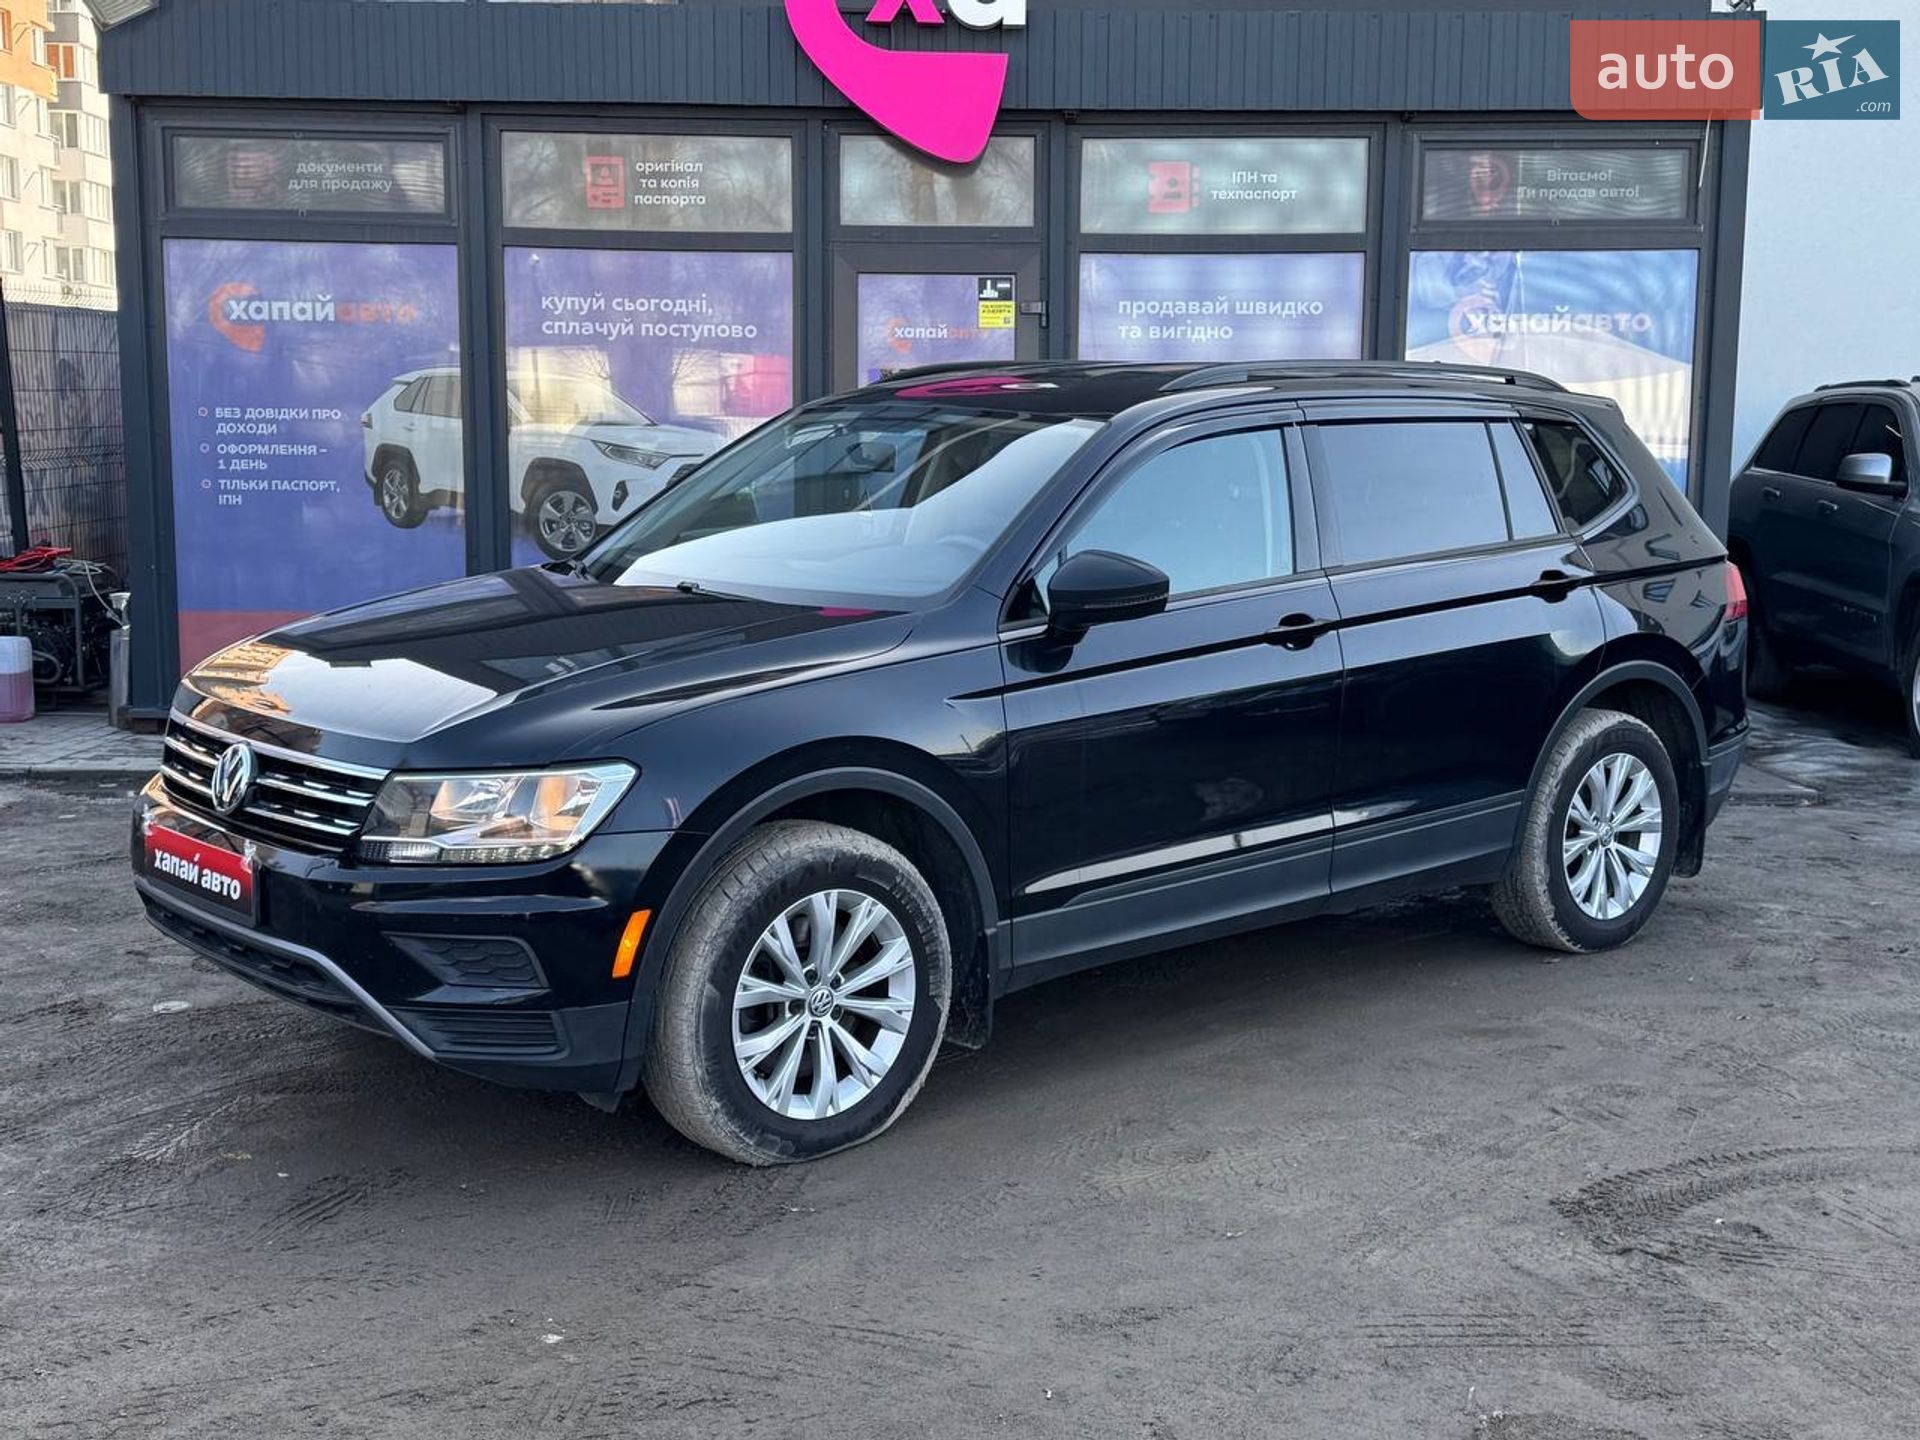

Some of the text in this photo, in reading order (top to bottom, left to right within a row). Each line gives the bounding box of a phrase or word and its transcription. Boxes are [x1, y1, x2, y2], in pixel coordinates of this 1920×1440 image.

[296, 162, 383, 176] документи
[635, 159, 704, 175] оригінал
[639, 175, 700, 189] та копія
[1231, 171, 1278, 183] ІПН та
[1546, 168, 1612, 182] Вітаємо!
[287, 179, 392, 193] для продажу
[1539, 187, 1596, 201] продав
[1599, 185, 1640, 199] авто!
[1210, 189, 1297, 202] техпаспорт
[541, 293, 714, 317] купуй сьогодні,
[1118, 296, 1324, 319] продавай швидко
[541, 318, 758, 342] сплачуй поступово
[1118, 319, 1234, 342] та вигідно
[215, 407, 342, 420] БЕЗ ДОВІДКИ ПРО
[215, 422, 277, 436] ДОХОДИ
[217, 443, 318, 456] ОФОРМЛЕННЯ
[218, 459, 268, 472] 1 ДЕНЬ
[218, 479, 341, 493] ТІЛЬКИ ПАСПОРТ,
[218, 494, 242, 505] ІПН
[200, 869, 241, 901] авто
